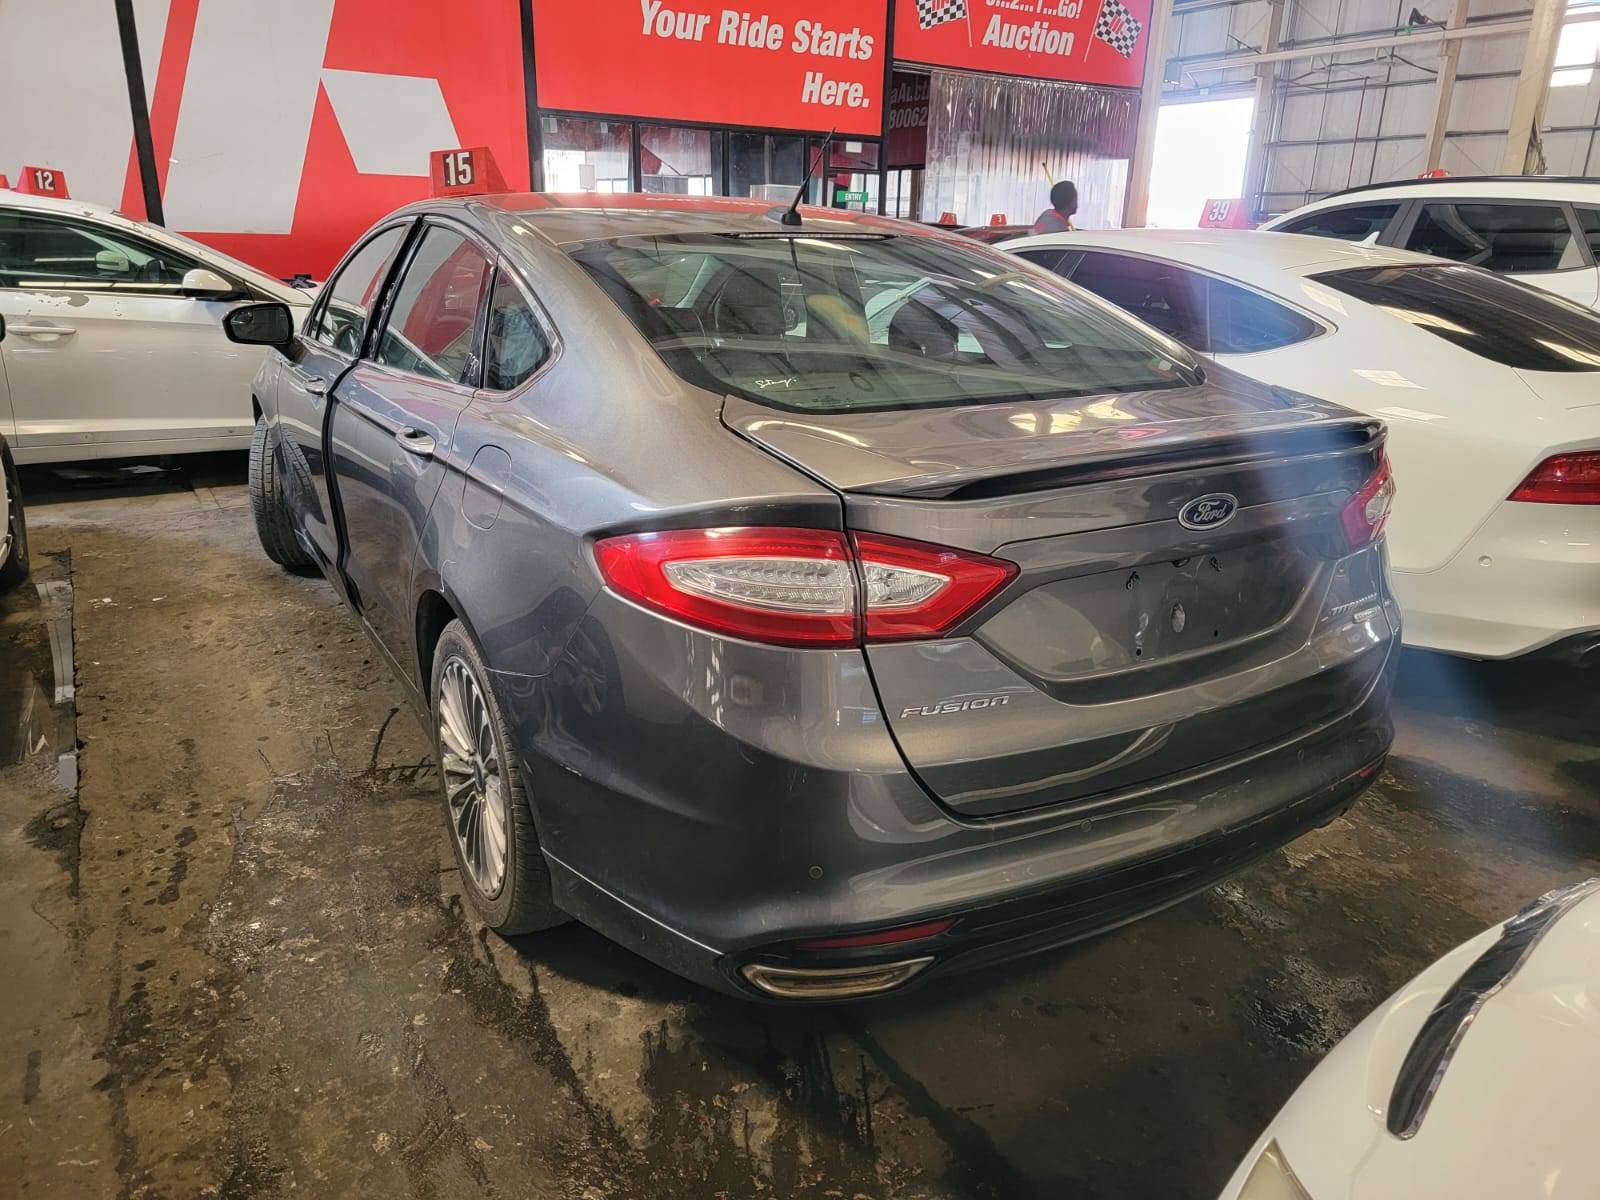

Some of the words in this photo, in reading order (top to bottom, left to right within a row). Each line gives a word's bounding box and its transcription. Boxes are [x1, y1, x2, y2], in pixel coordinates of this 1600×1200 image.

[640, 0, 711, 42] Your
[717, 9, 784, 51] Ride
[791, 20, 874, 61] Starts
[981, 14, 1075, 56] Auction
[801, 71, 870, 108] Here.
[35, 170, 54, 190] 12
[445, 151, 472, 186] 15
[844, 193, 862, 201] ENTRY
[1208, 200, 1231, 221] 39
[1193, 500, 1228, 522] Ford
[900, 695, 1010, 719] FUSION
